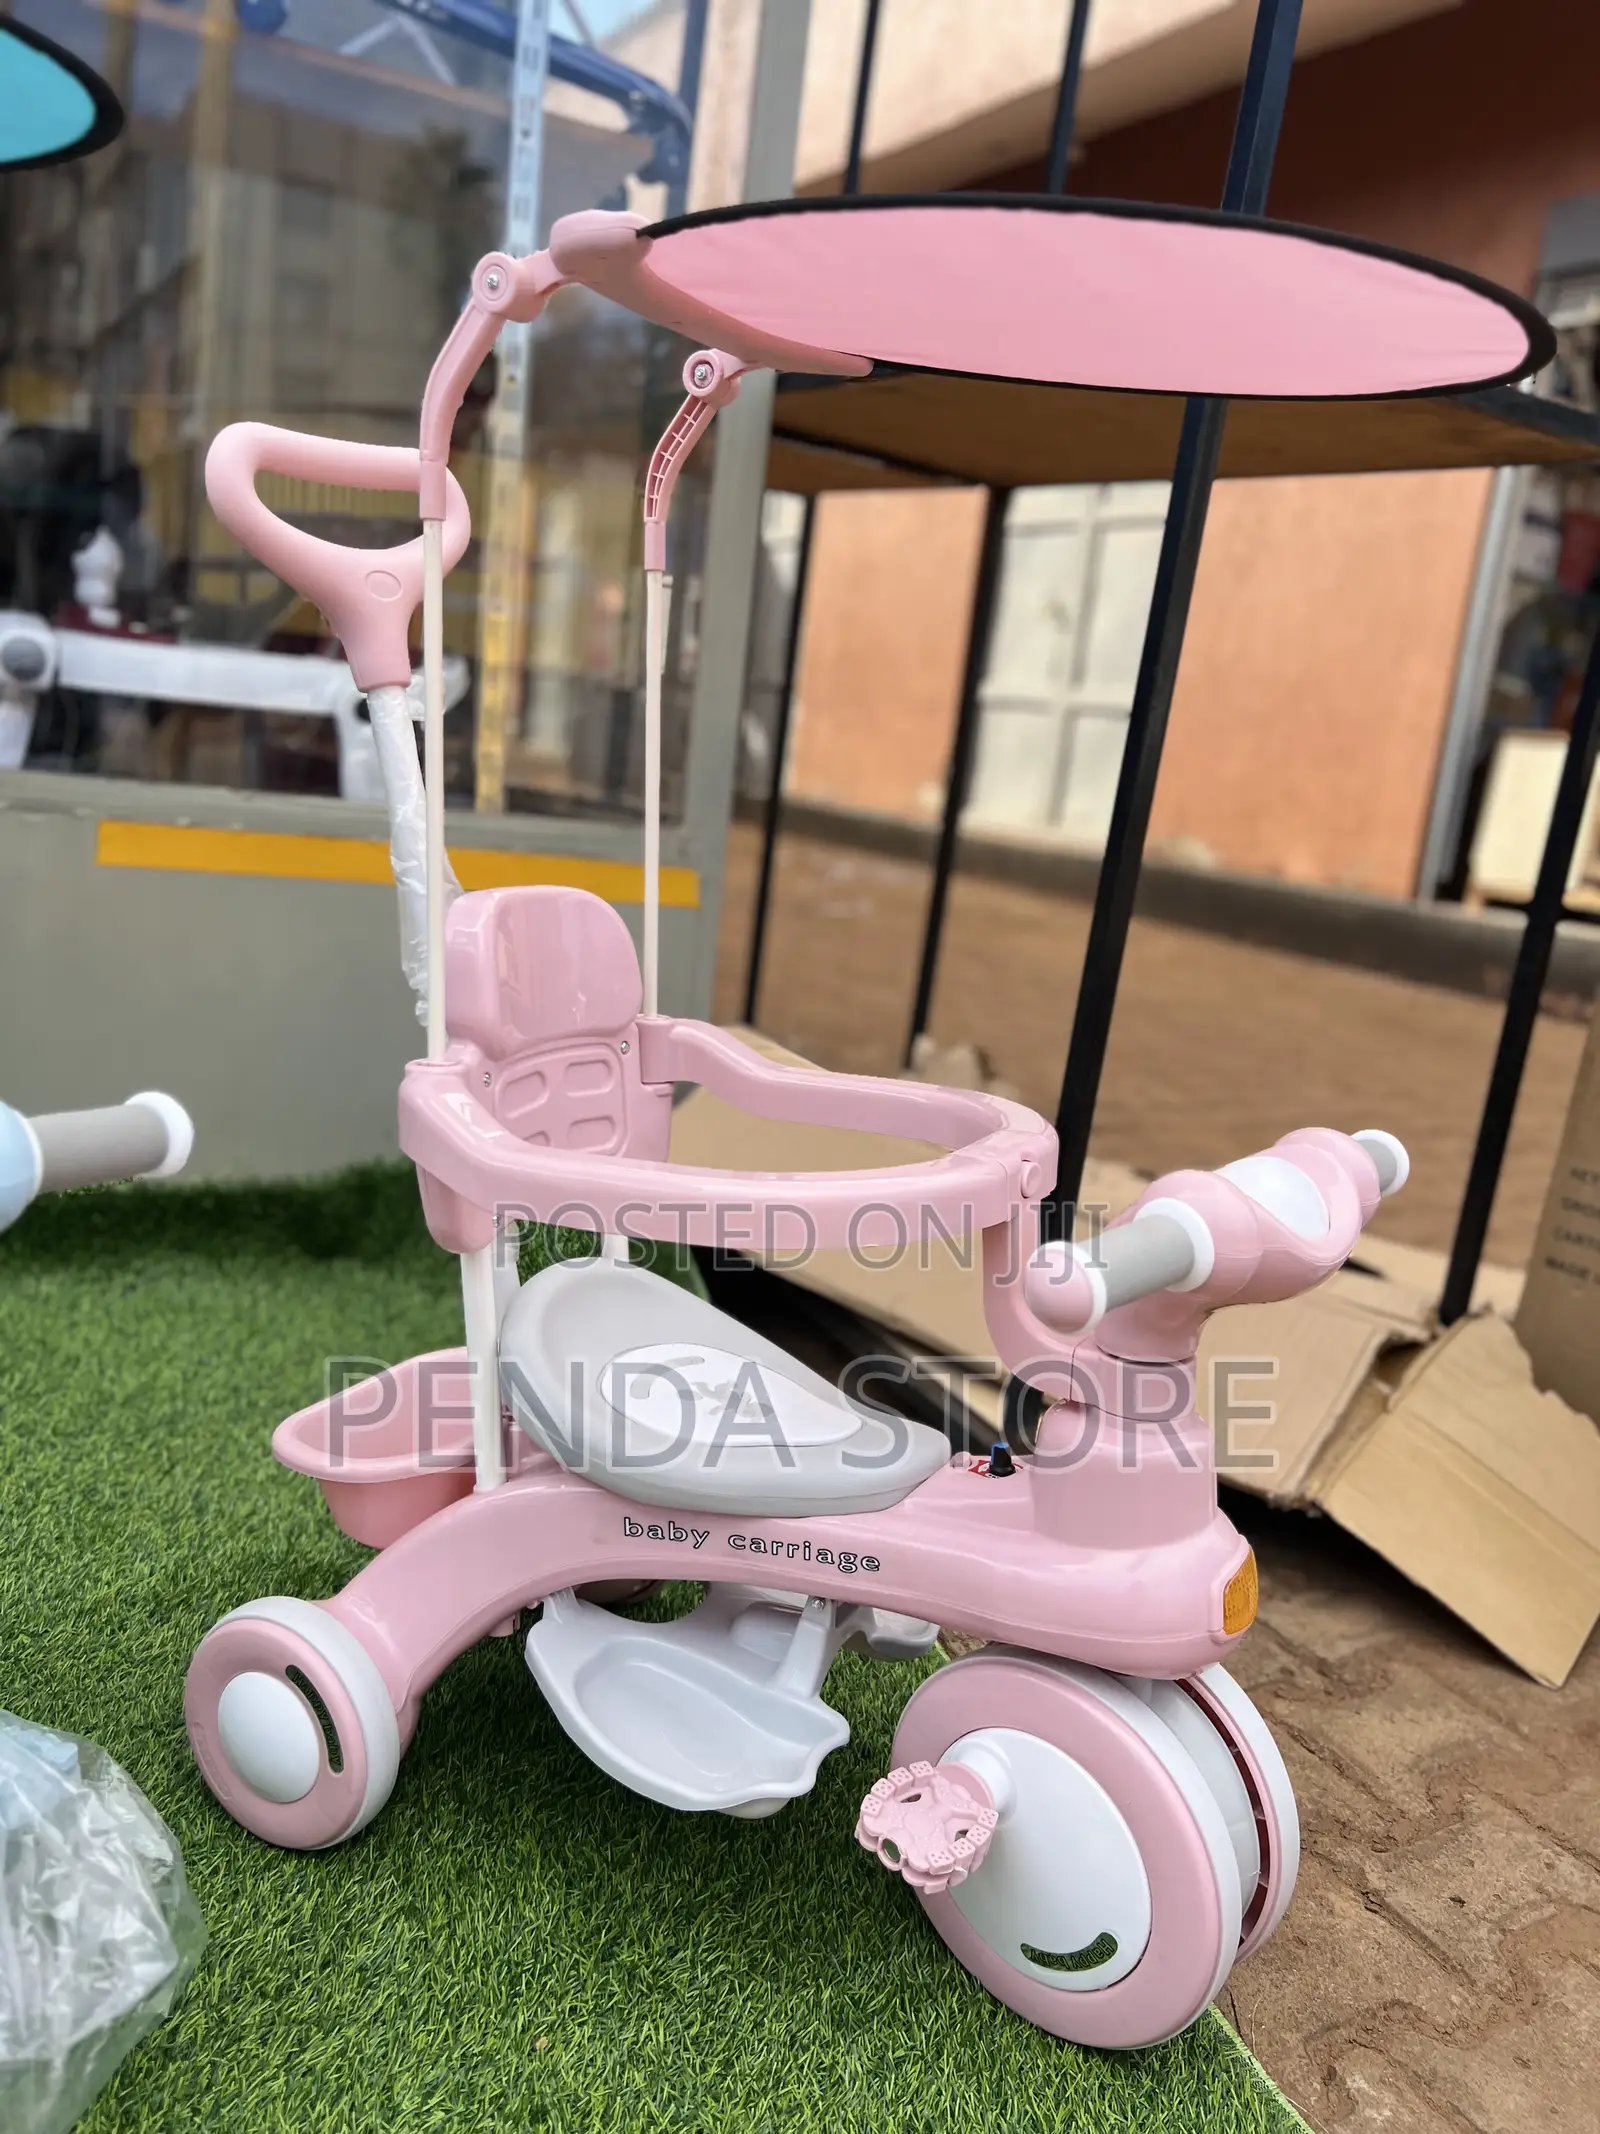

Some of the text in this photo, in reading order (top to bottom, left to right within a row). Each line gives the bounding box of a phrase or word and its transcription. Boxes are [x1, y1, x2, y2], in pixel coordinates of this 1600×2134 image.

[624, 1517, 881, 1573] baby carriage
[1030, 1938, 1115, 1970] Happy baby
